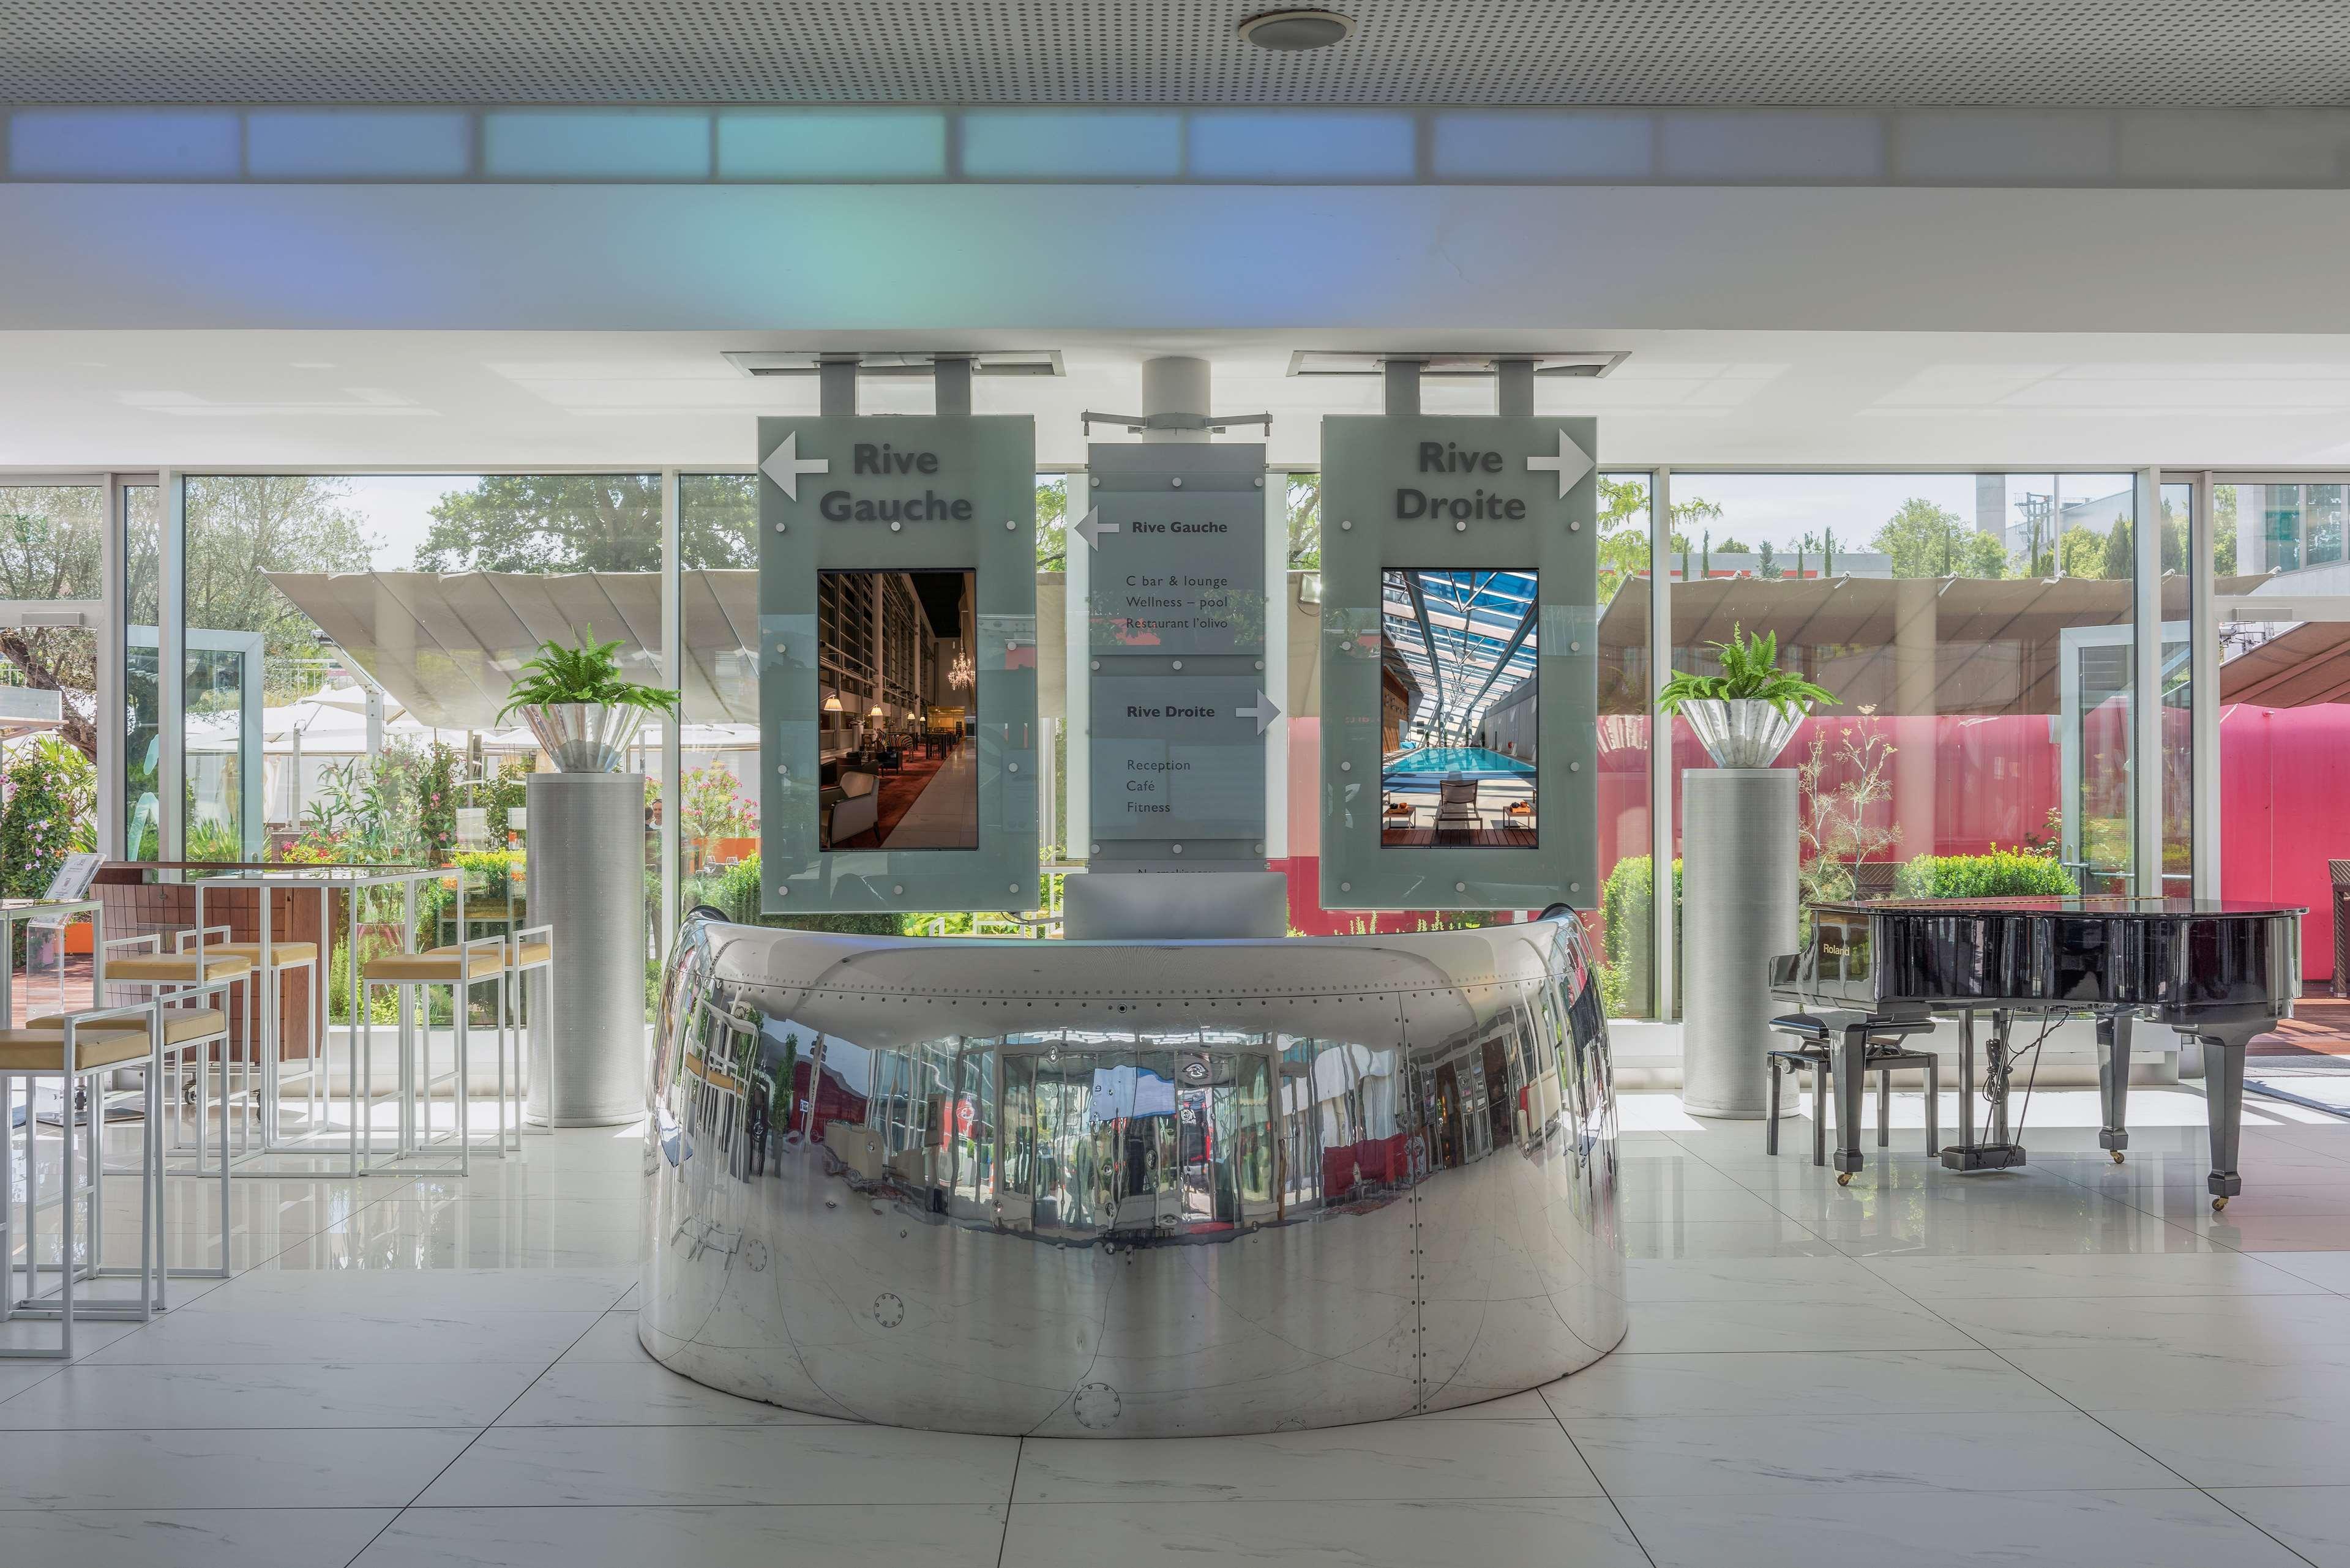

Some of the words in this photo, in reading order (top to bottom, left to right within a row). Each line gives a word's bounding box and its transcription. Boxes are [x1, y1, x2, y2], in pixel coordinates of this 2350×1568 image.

[853, 443, 938, 475] Rive
[1419, 442, 1503, 474] Rive
[820, 490, 973, 521] Gauche
[1396, 488, 1526, 520] Droite
[1132, 521, 1166, 534] Rive
[1170, 521, 1228, 534] Gauche
[1126, 575, 1136, 586] C
[1142, 575, 1164, 586] bar
[1169, 576, 1178, 586] &
[1184, 575, 1228, 589] lounge
[1126, 596, 1182, 608] Wellness
[1200, 596, 1228, 610] pool
[1126, 618, 1189, 629] Restaurant
[1193, 618, 1228, 629] l'olivo
[1127, 706, 1161, 717] Rive
[1166, 706, 1215, 717] Droite
[1127, 760, 1191, 773] Reception
[1126, 780, 1155, 792] Café
[1127, 802, 1171, 813] Fitness
[1823, 943, 1850, 956] Roland
